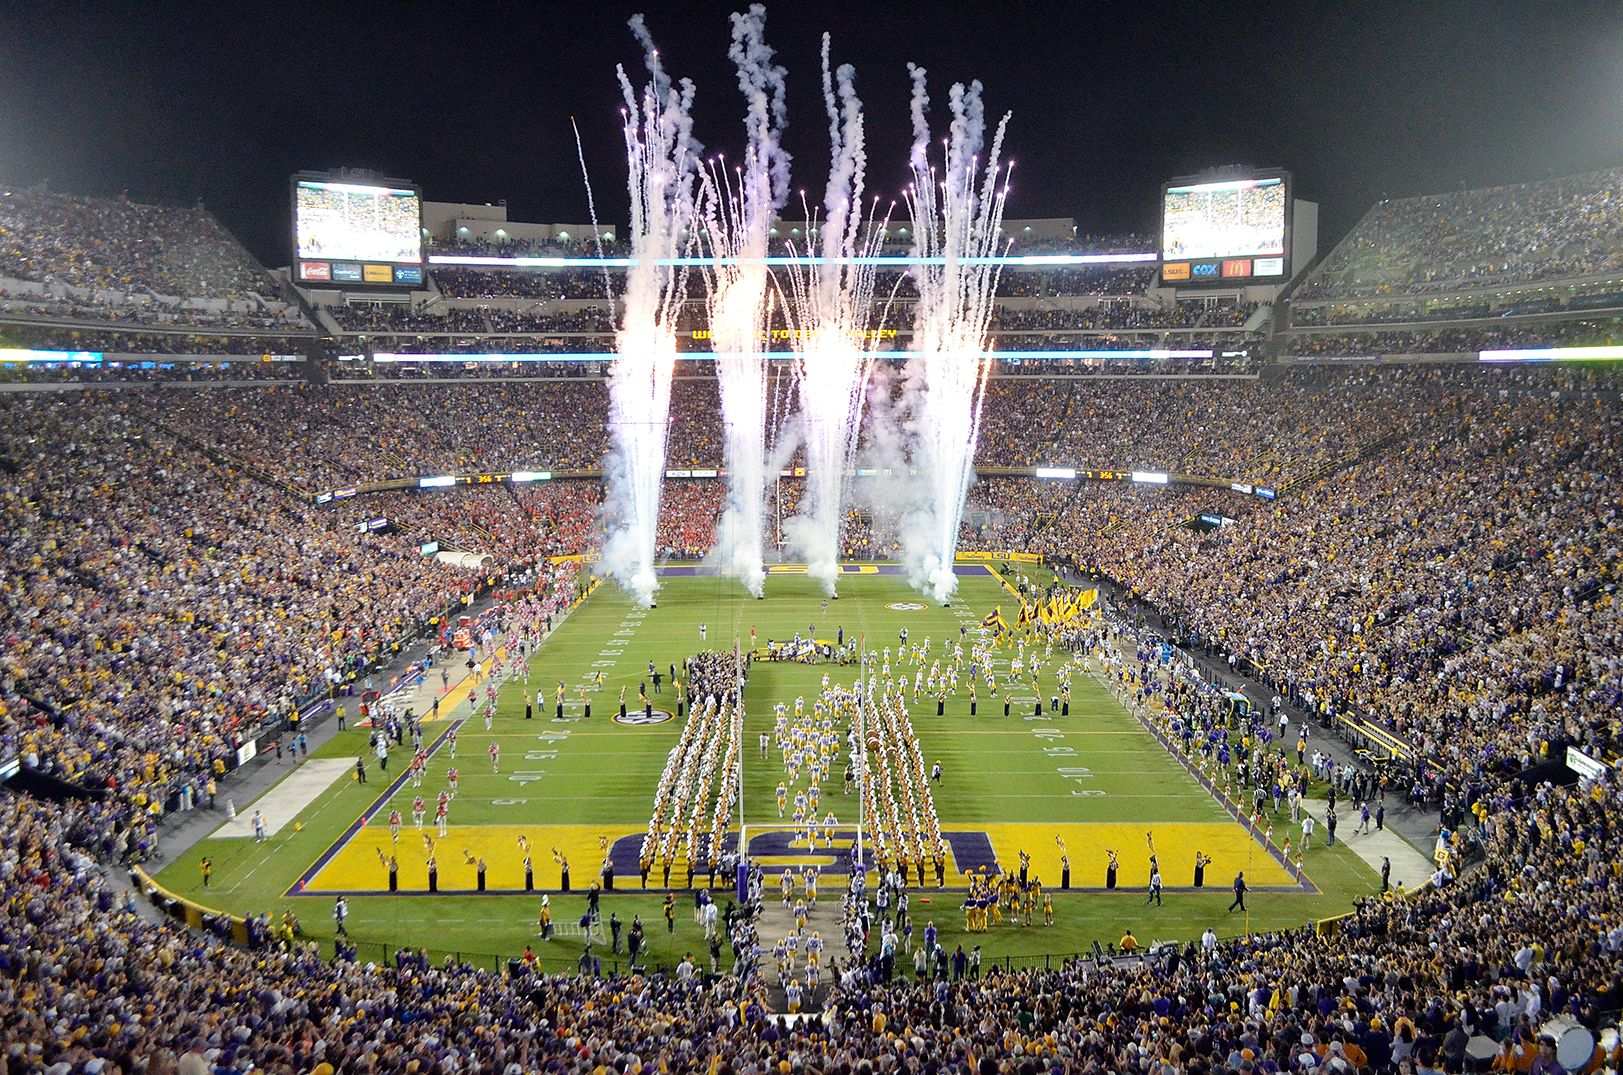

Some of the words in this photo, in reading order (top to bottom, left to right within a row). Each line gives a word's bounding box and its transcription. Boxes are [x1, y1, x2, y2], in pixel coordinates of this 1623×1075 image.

[1192, 264, 1218, 276] COX
[771, 329, 790, 339] TO
[991, 552, 1011, 560] LSU
[508, 770, 546, 781] 10
[1056, 767, 1094, 777] 10
